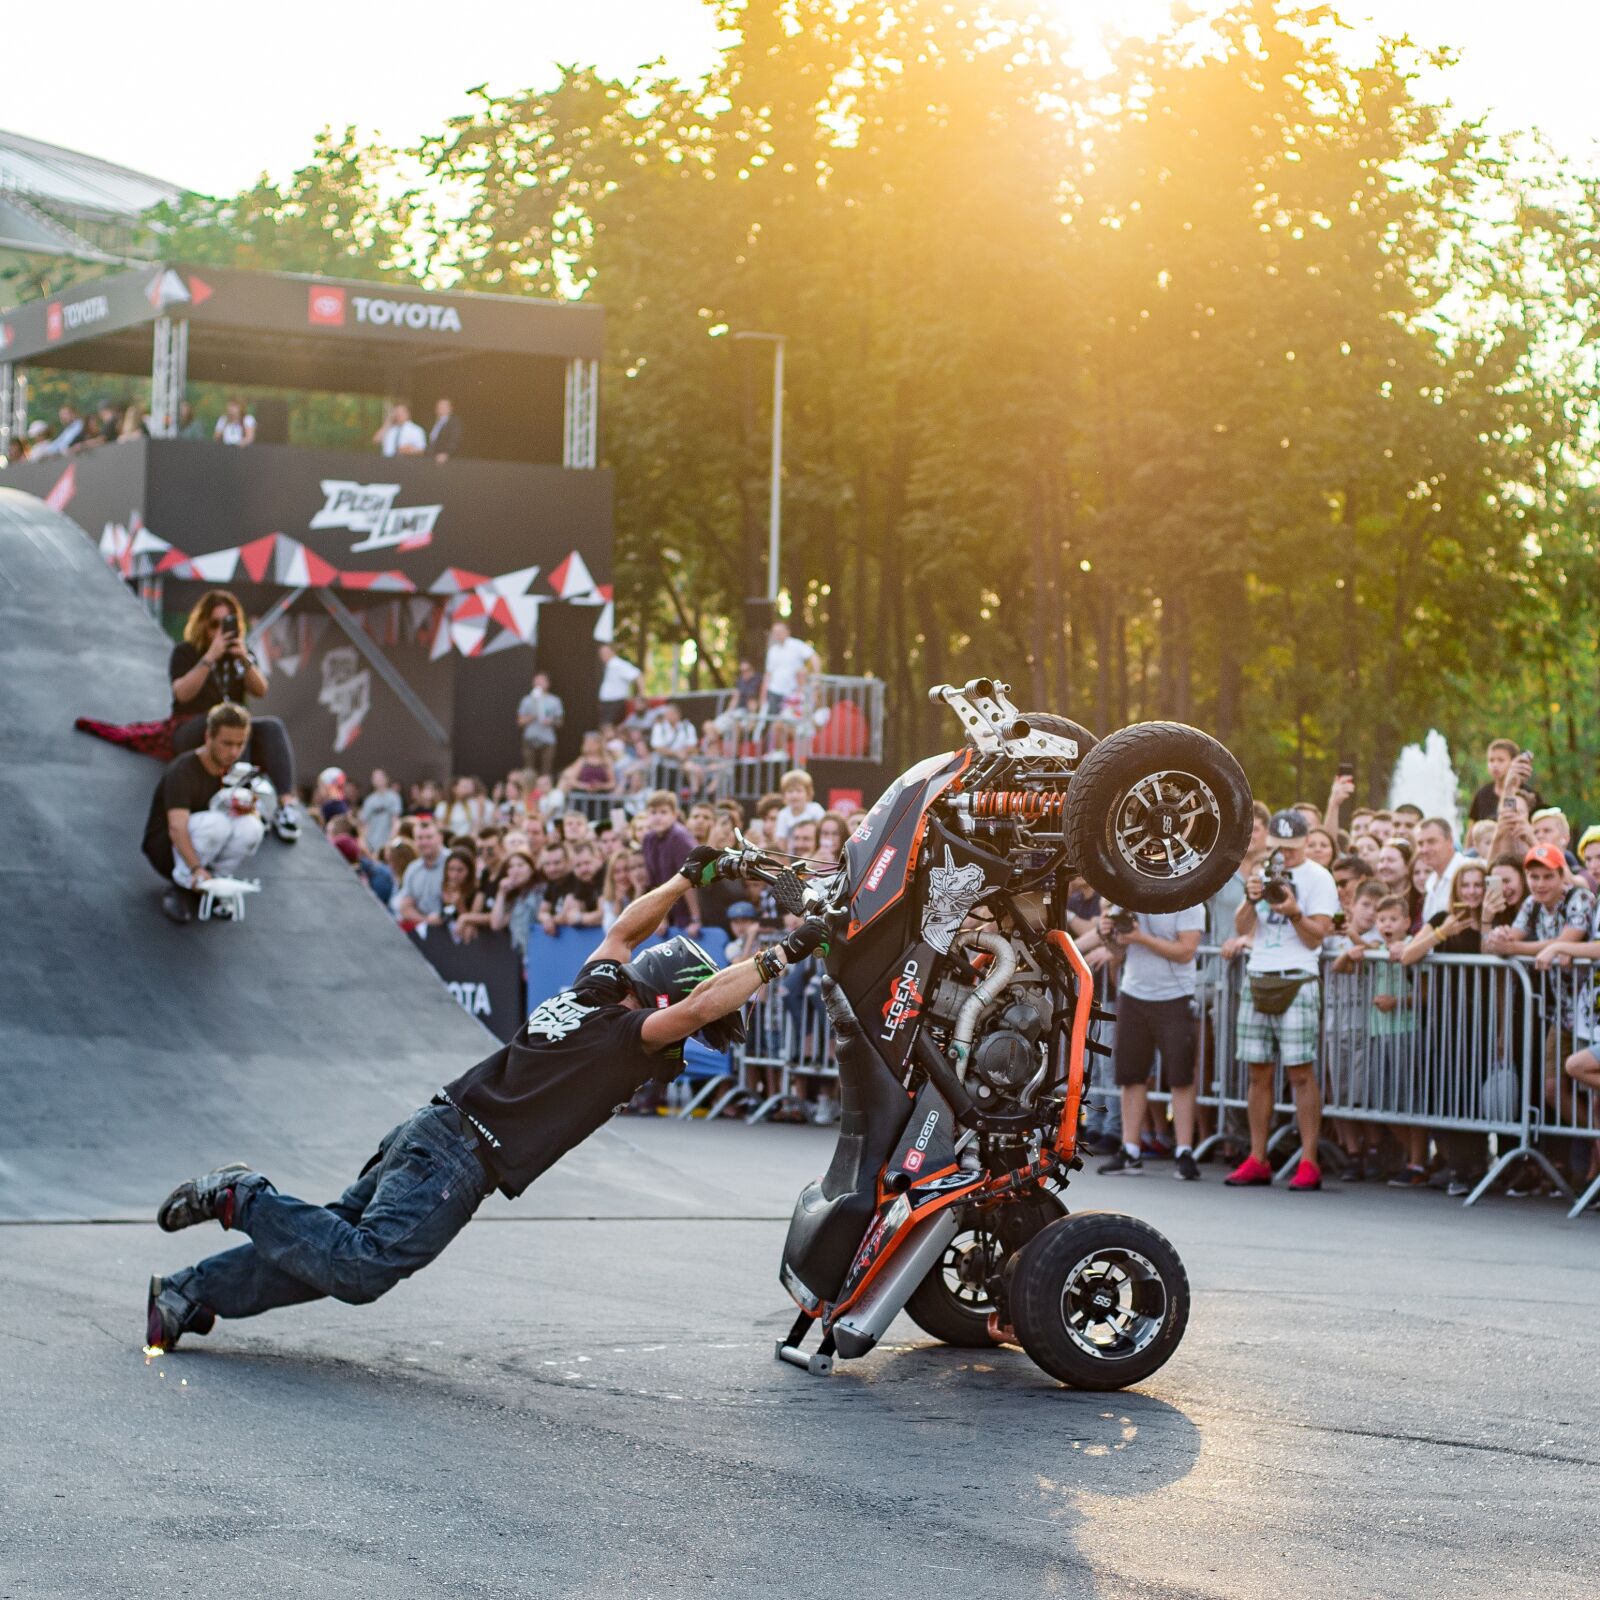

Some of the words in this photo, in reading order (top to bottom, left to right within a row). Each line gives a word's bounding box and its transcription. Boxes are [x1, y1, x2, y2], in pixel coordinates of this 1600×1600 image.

[63, 295, 109, 330] TOYOTA
[351, 296, 462, 333] TOYOTA
[867, 848, 896, 889] MOTUL
[881, 959, 919, 1041] LEGEND
[899, 1002, 912, 1030] STUNT
[908, 977, 921, 1001] TEAM
[915, 1110, 940, 1151] OGIO
